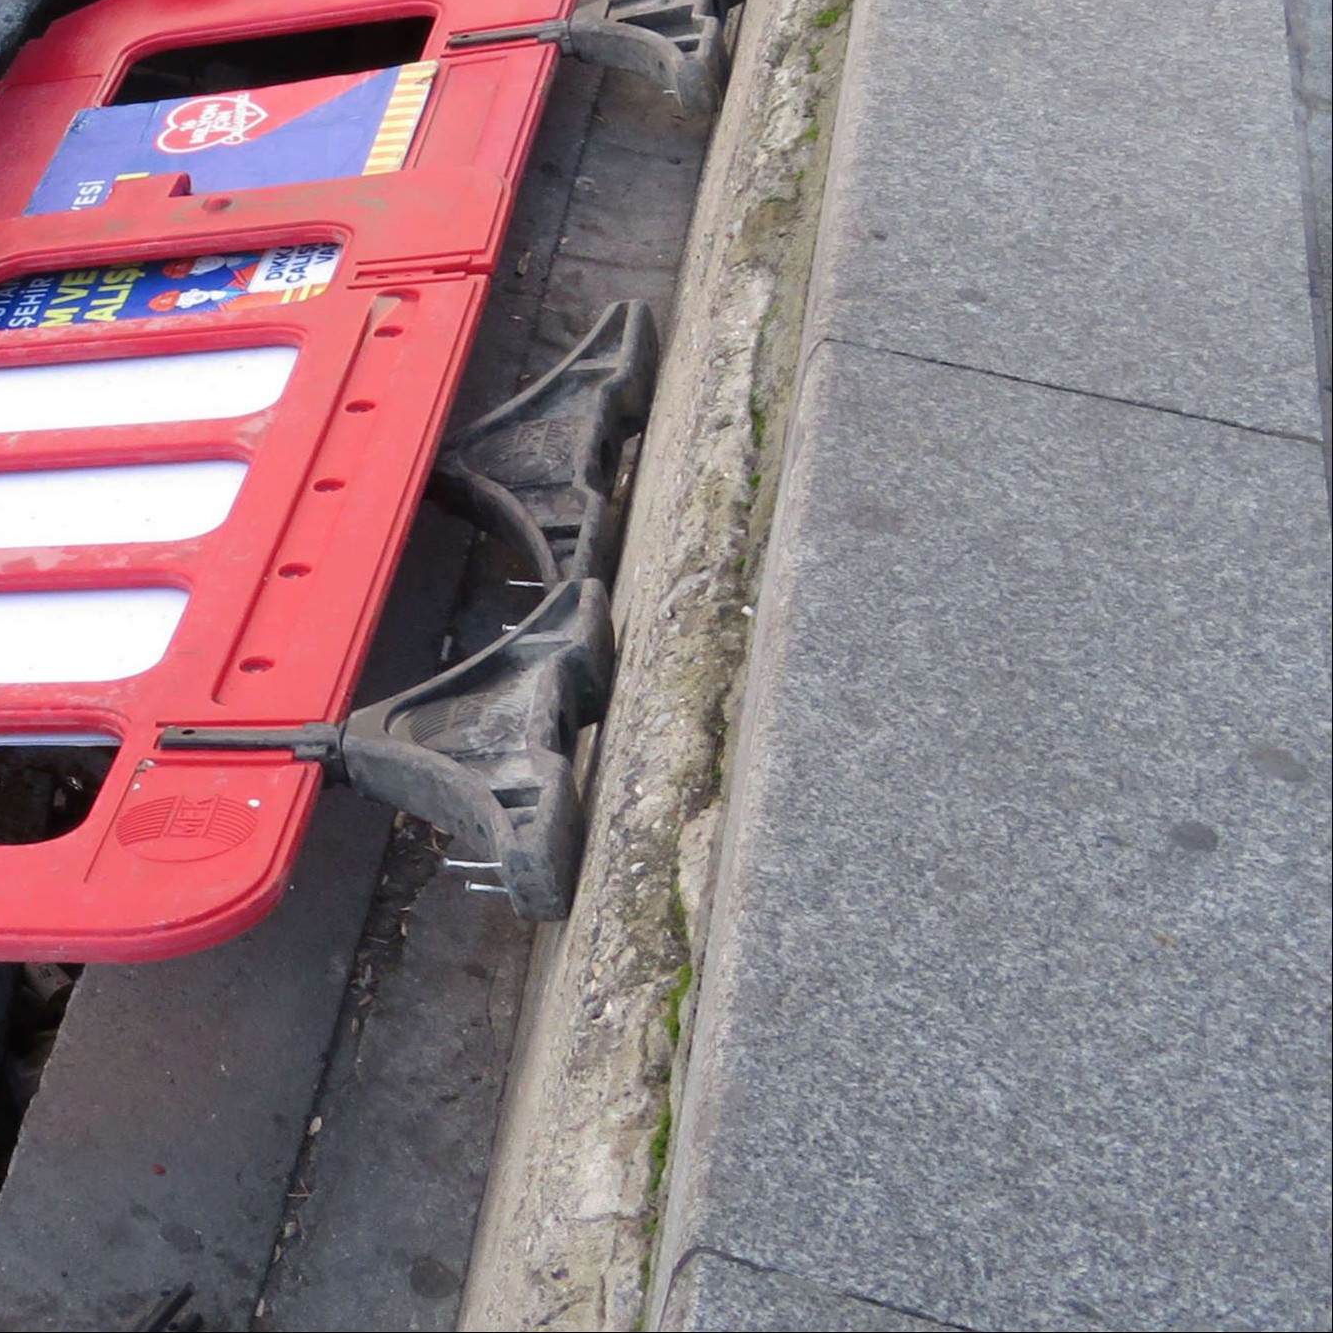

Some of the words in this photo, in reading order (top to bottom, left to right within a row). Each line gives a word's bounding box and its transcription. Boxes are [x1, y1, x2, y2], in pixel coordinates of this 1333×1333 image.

[7, 277, 55, 330] ŞEHİR
[49, 271, 99, 305] VE
[84, 266, 146, 322] ALIŞ
